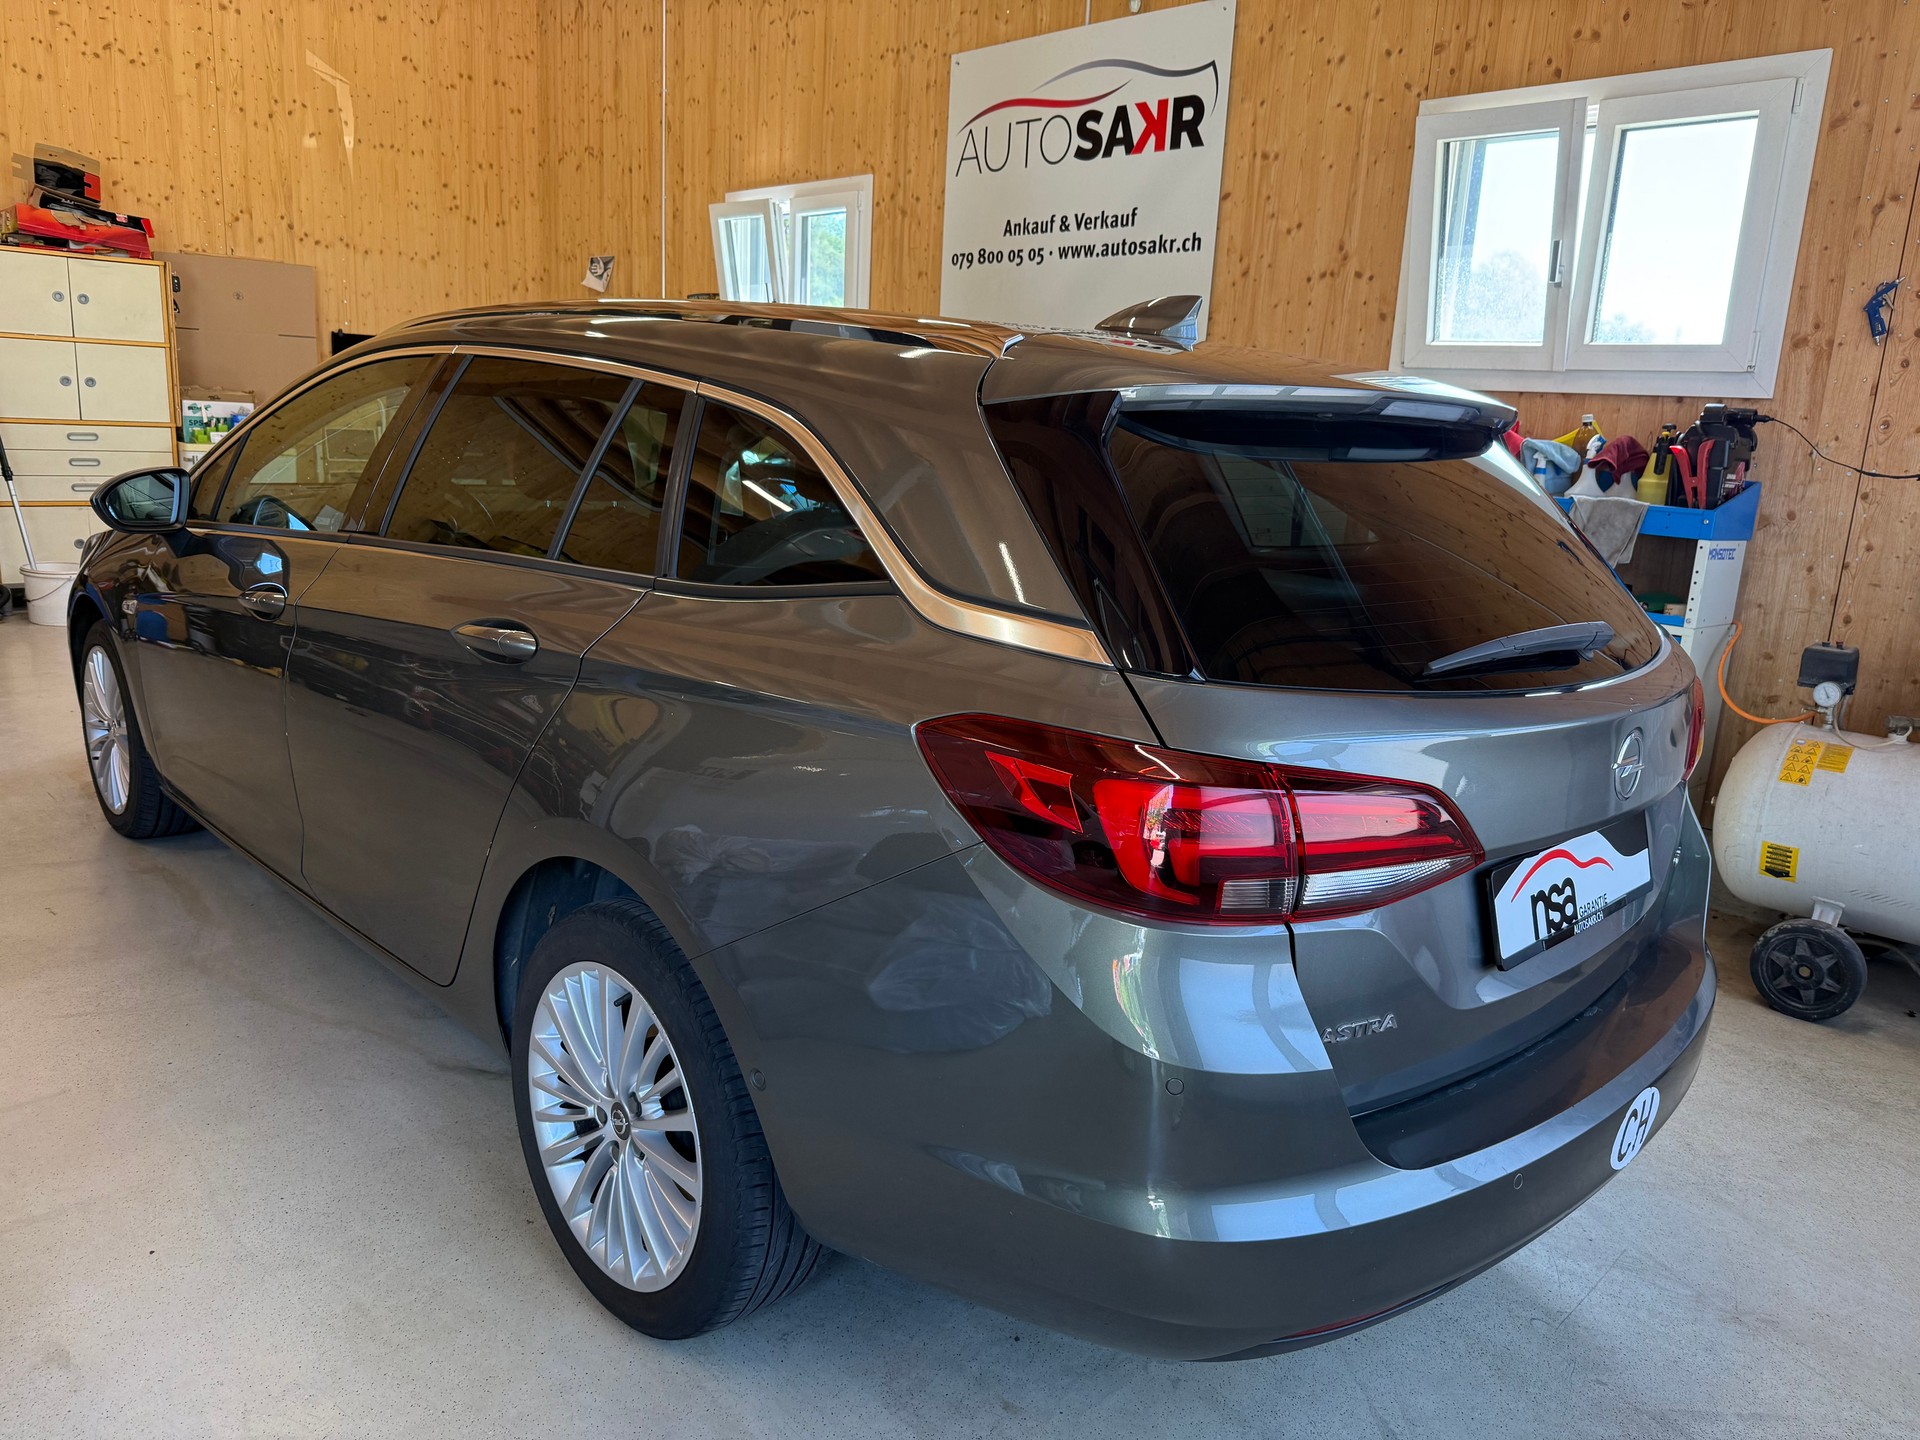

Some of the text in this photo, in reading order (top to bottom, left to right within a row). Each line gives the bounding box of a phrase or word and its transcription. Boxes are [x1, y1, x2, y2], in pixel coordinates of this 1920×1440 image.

[955, 94, 1205, 178] AUTOSAKR
[1003, 207, 1138, 237] Ankauf & Verkauf
[951, 252, 974, 270] 079
[977, 248, 1004, 265] 800
[1007, 249, 1024, 267] 05
[1028, 247, 1044, 265] 05
[1058, 232, 1202, 260] www.autosakr.ch
[1531, 877, 1579, 941] nsa
[1579, 893, 1608, 918] GARANTIE
[1321, 1013, 1398, 1043] ASTRA
[1617, 1087, 1655, 1163] CH
